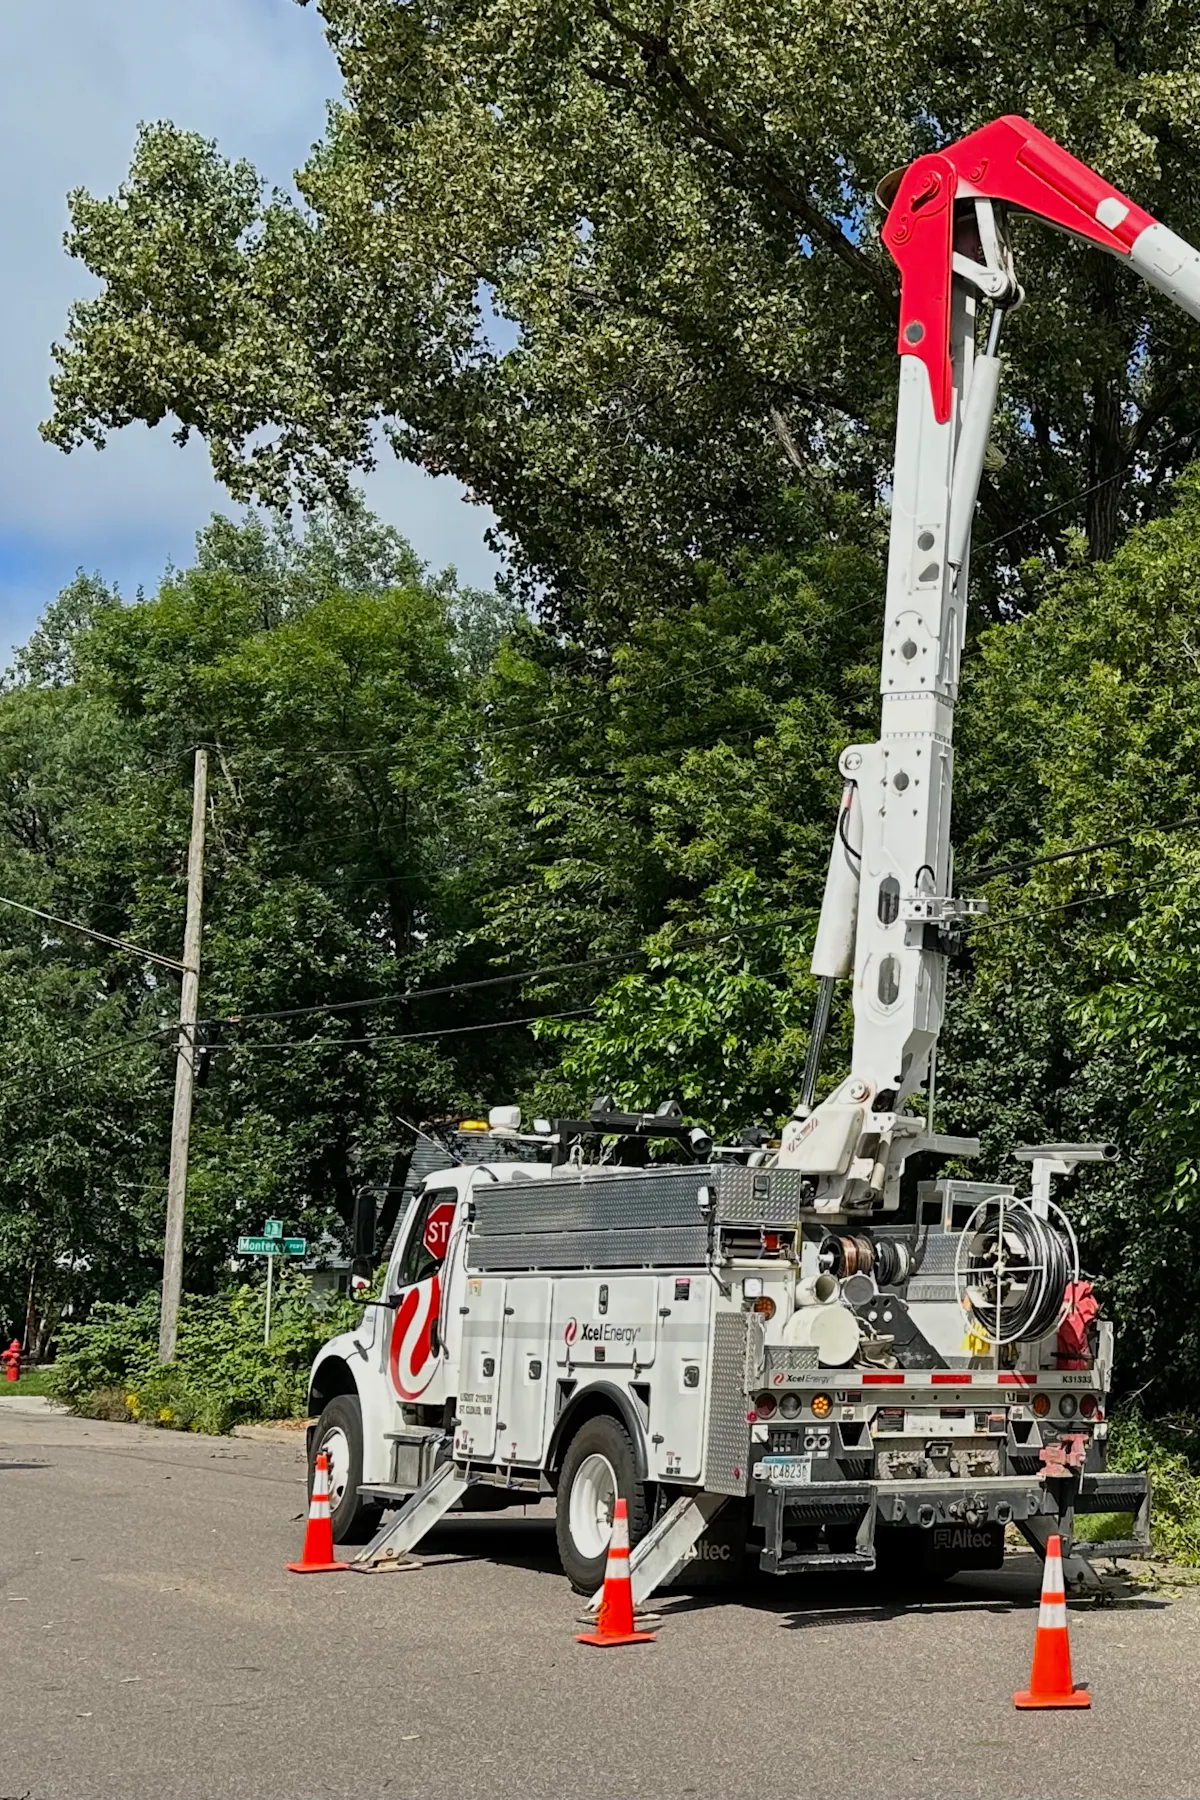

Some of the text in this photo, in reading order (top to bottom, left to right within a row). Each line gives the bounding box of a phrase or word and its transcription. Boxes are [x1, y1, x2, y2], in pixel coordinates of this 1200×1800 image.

[428, 1221, 449, 1243] ST
[240, 1239, 287, 1252] Monterey
[581, 1324, 637, 1346] Xcel Energy
[786, 1374, 805, 1383] Xcel
[952, 1529, 992, 1548] Altec
[684, 1540, 730, 1560] Altec
